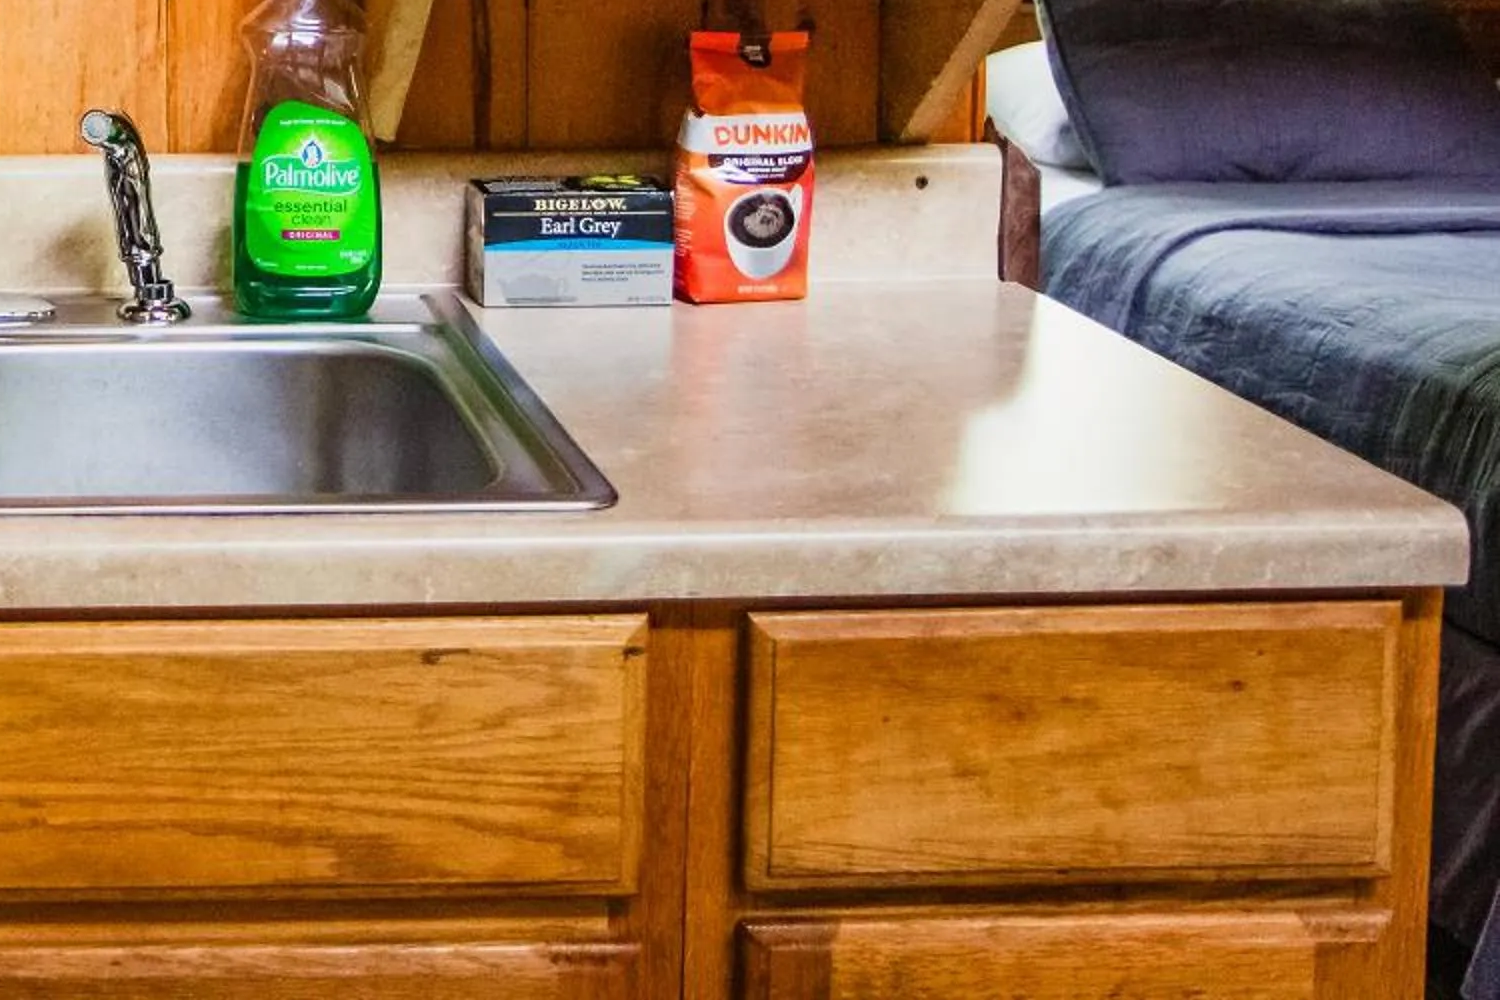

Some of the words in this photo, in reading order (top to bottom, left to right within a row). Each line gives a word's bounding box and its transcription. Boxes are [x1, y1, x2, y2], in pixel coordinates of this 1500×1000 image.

[713, 122, 810, 146] DUNKIN
[265, 161, 358, 188] Palmolive
[273, 199, 348, 213] essential
[534, 197, 624, 211] BIGELOW
[291, 213, 332, 226] clean
[539, 216, 576, 235] Earl
[579, 216, 622, 239] Grey
[288, 231, 334, 240] ORIGINAL
